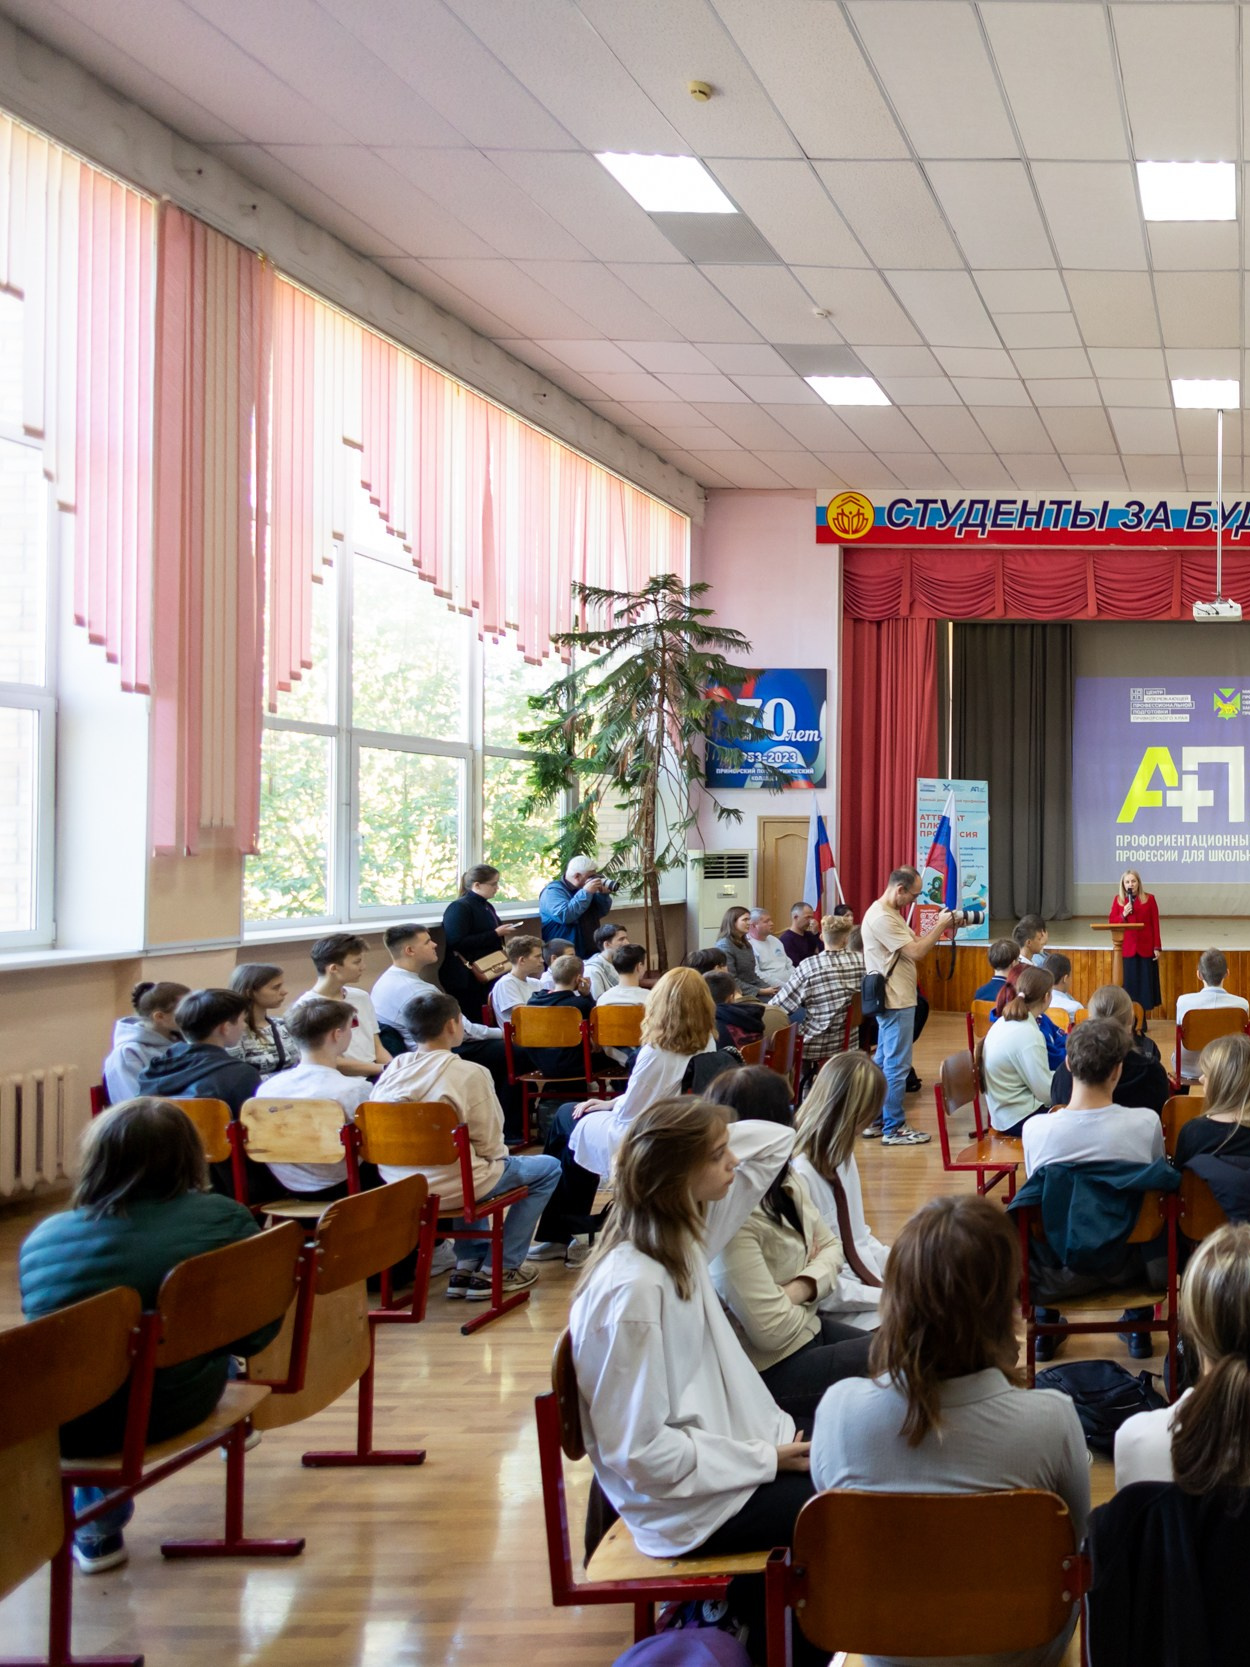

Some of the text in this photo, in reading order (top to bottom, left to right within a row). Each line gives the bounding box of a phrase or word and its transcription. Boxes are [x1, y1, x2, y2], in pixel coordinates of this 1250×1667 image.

[885, 498, 1110, 538] СТУДЕНТЫ
[1119, 500, 1174, 532] ЗА
[785, 729, 822, 742] лет
[742, 752, 797, 763] 53-2023
[920, 830, 978, 838] ПРСИЯ
[1116, 849, 1179, 862] ПРОФЕССИИ
[1181, 849, 1205, 864] ДЛЯ
